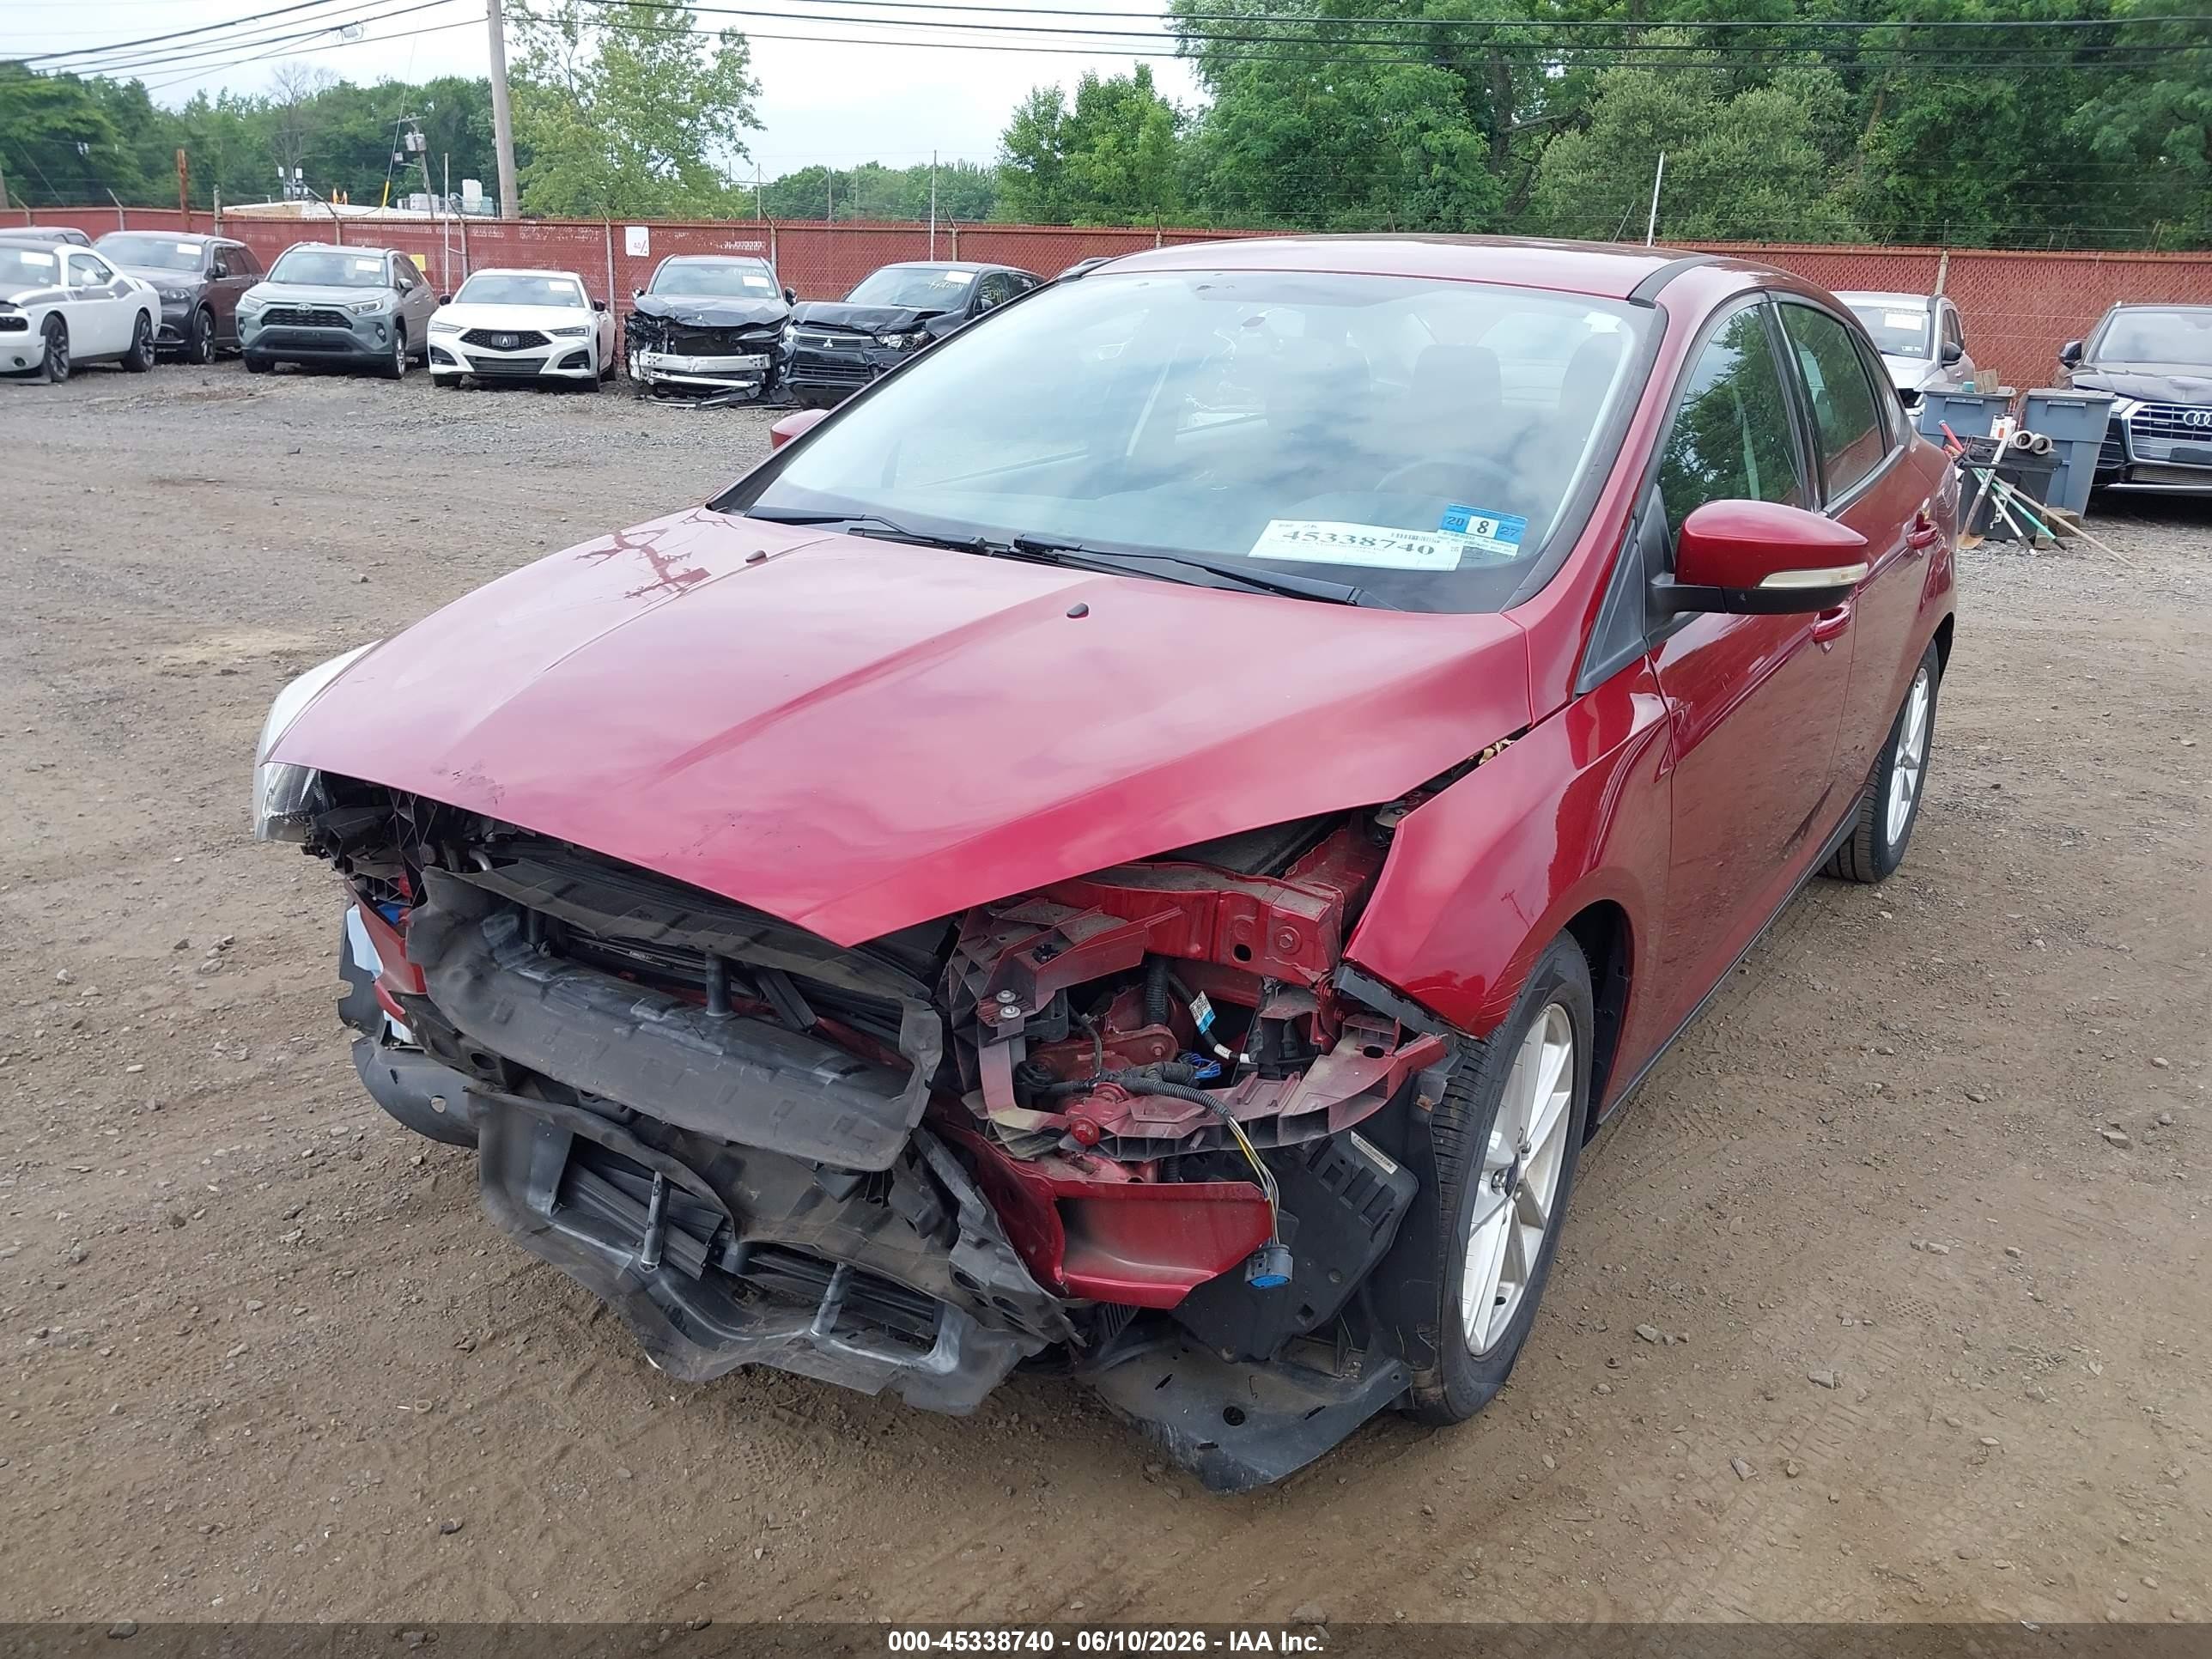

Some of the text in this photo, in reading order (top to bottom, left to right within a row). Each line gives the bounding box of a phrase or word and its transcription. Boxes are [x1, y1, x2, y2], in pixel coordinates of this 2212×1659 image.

[1446, 516, 1465, 526] 20
[1476, 520, 1490, 534] 8
[1498, 526, 1519, 538] 27
[1282, 531, 1435, 556] 45338740
